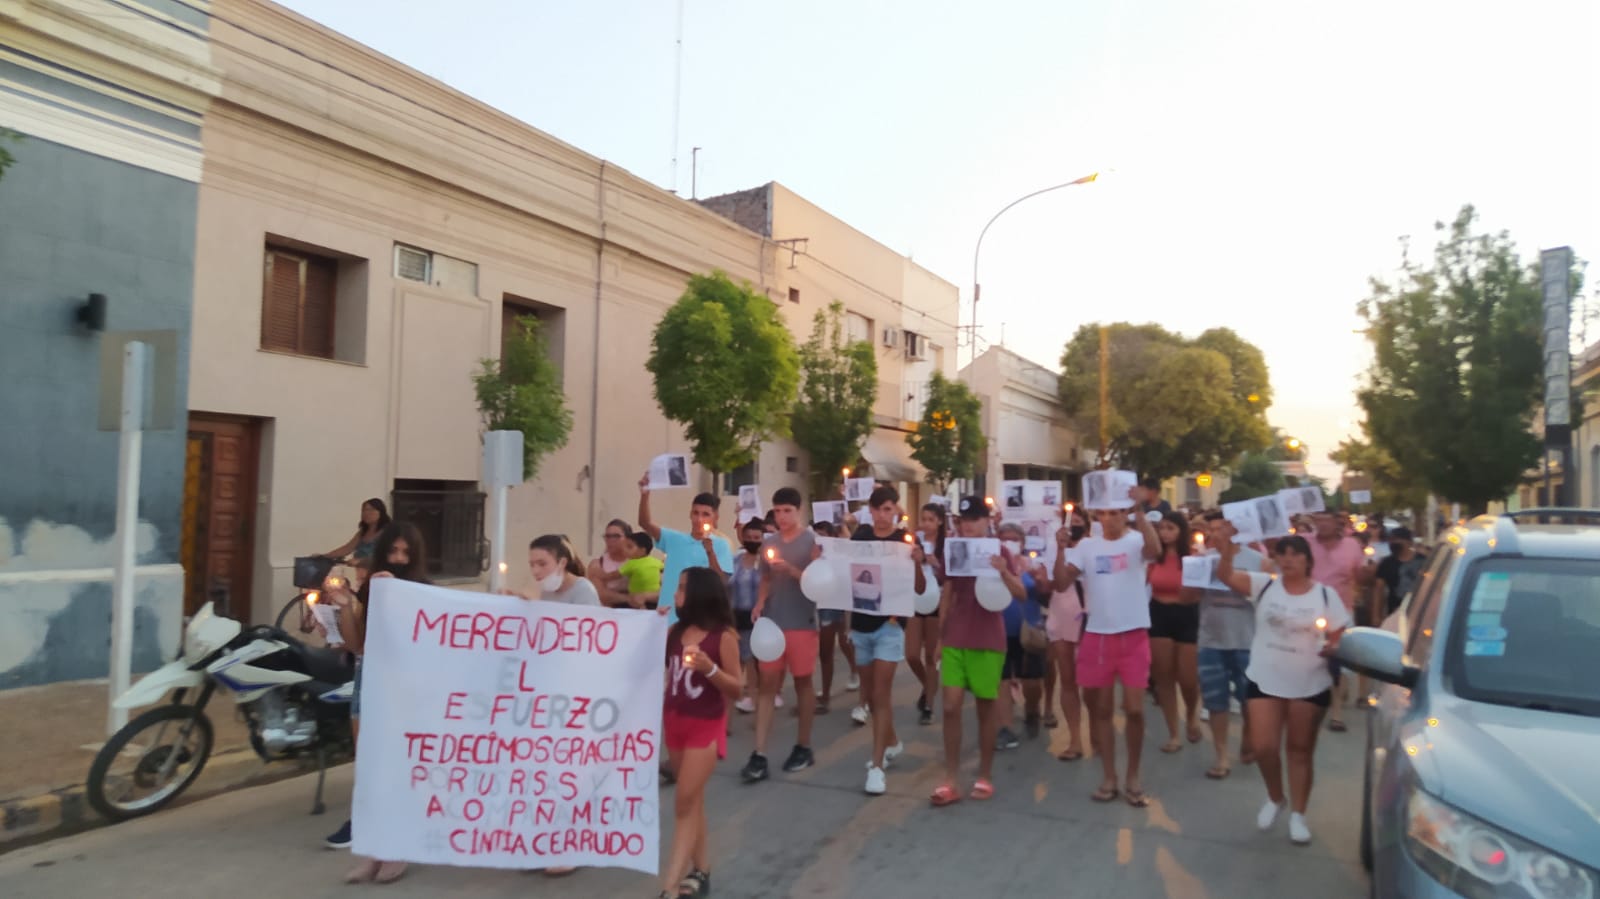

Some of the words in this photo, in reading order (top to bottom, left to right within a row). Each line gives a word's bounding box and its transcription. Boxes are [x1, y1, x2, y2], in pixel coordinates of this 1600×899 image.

[412, 608, 619, 655] MERENDERO
[496, 656, 536, 692] EL
[444, 692, 621, 733] ESFUERZO
